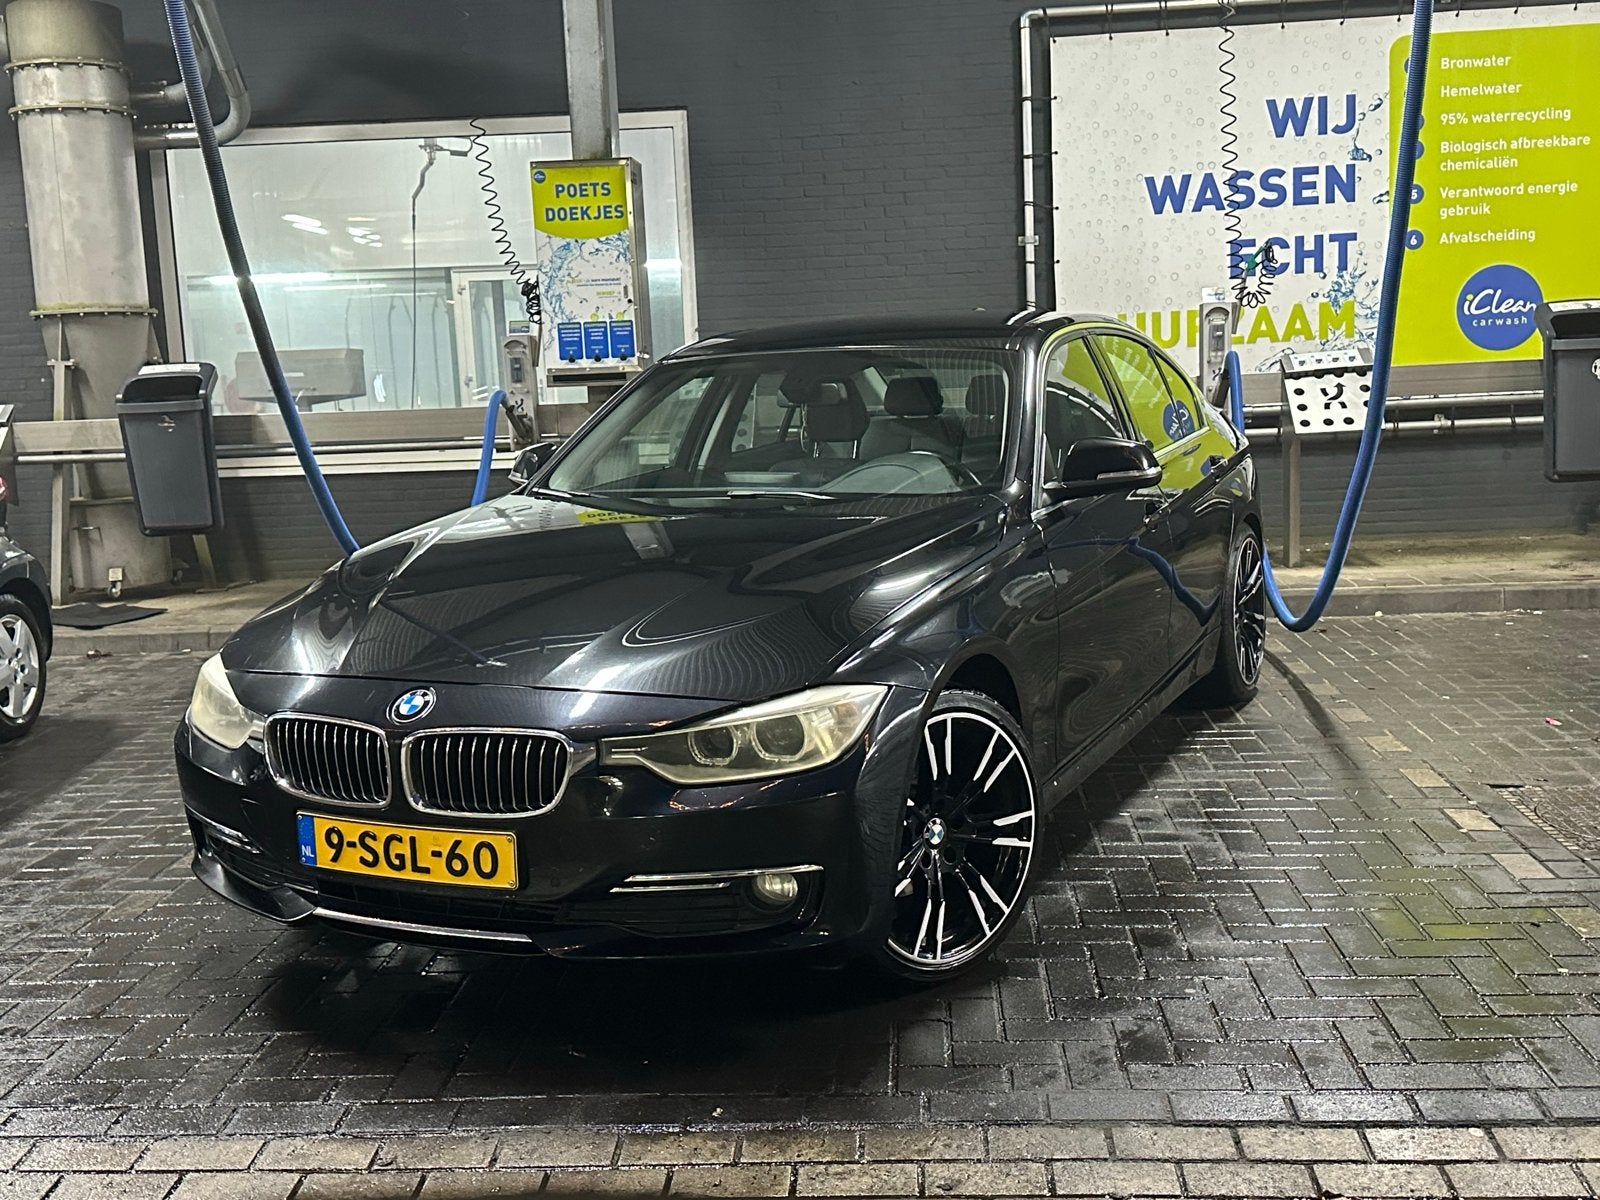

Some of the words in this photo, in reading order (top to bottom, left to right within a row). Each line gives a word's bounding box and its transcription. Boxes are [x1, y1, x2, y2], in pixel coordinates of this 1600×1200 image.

[1440, 55, 1511, 69] Bronwater
[1440, 83, 1522, 97] Hemelwater
[1266, 94, 1356, 138] WIJ
[1440, 112, 1468, 125] 95%
[1472, 108, 1571, 124] waterrecycling
[1440, 139, 1507, 154] Biologisch
[1510, 135, 1591, 149] afbreekbare
[1440, 157, 1518, 171] chemicaliën
[555, 182, 611, 199] POETS
[1144, 164, 1356, 215] WASSEN
[1440, 184, 1524, 199] Verantwoord
[1527, 181, 1578, 196] energie
[545, 204, 625, 222] DOEKJES
[1440, 204, 1490, 219] gebruik
[1410, 234, 1418, 246] 6
[1439, 229, 1536, 244] Afvalscheiding
[1463, 288, 1537, 316] iClean
[1472, 315, 1528, 327] carwash
[301, 844, 315, 858] NL
[324, 825, 499, 880] 9-SGL-60
